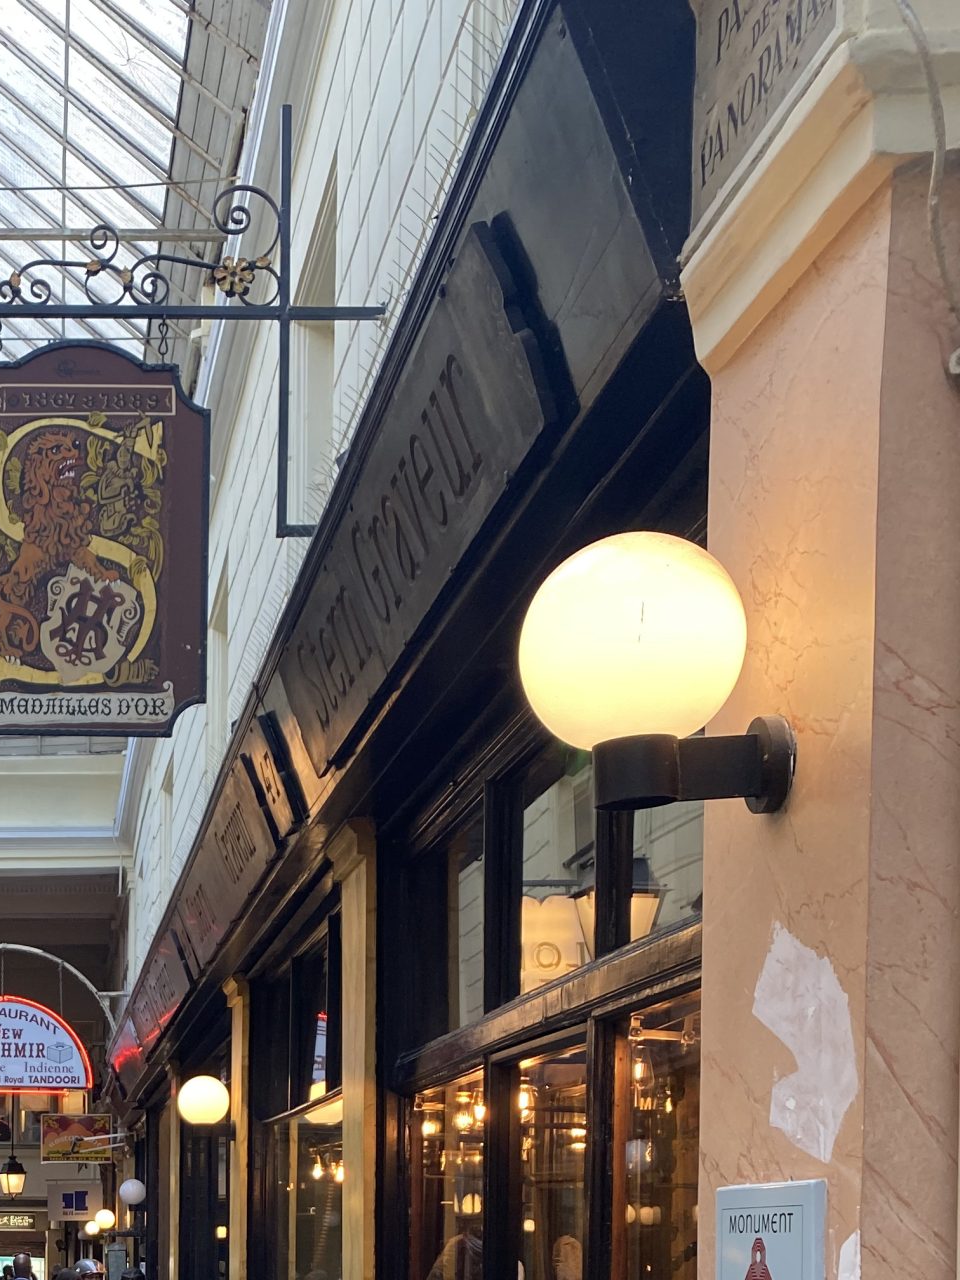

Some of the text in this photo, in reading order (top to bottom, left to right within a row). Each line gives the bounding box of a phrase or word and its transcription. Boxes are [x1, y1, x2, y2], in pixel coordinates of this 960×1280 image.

[24, 1061, 74, 1073] Indienne
[29, 1075, 80, 1084] TANDOORI
[728, 1212, 794, 1235] MONUMENT
